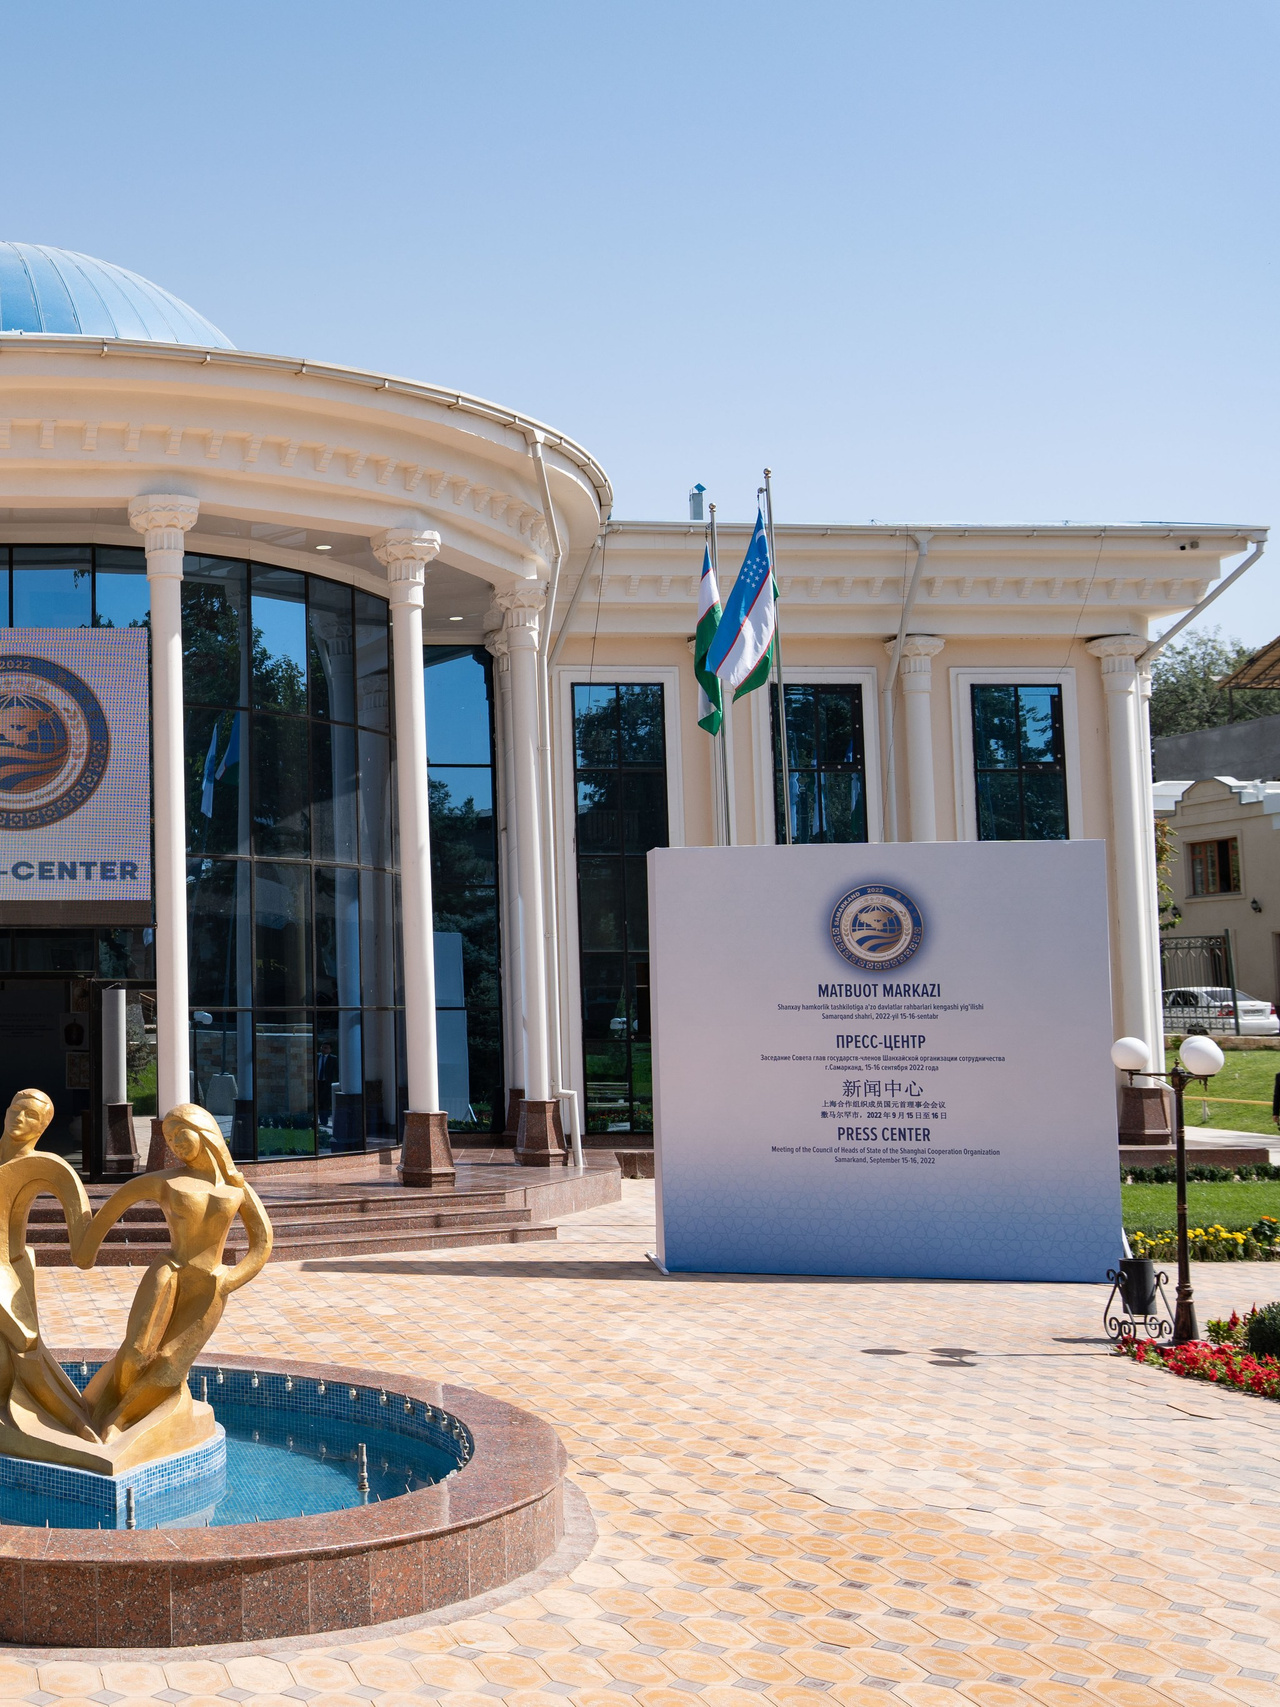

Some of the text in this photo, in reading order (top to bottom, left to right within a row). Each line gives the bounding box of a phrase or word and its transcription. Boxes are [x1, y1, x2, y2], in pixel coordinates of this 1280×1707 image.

[834, 891, 861, 926] SAMARKAND
[818, 983, 941, 997] MATBUOT MARKAZI
[778, 1003, 801, 1012] Shanxay
[830, 1003, 864, 1012] tashkilotiga
[877, 1003, 903, 1012] davlatlar
[875, 1012, 899, 1021] 2022-yil
[836, 1034, 926, 1051] ПРЕСС-ЦЕНТР
[827, 1054, 882, 1062] государств-членов
[882, 1055, 919, 1063] Шанхайской
[881, 1064, 908, 1072] сентября
[842, 1079, 924, 1098] 新闻中心
[838, 1126, 931, 1141] PRESS CENTER
[772, 1146, 795, 1154] Meeting
[900, 1146, 927, 1156] Shanghai
[927, 1148, 963, 1156] Cooperation
[963, 1148, 1001, 1156] Organization
